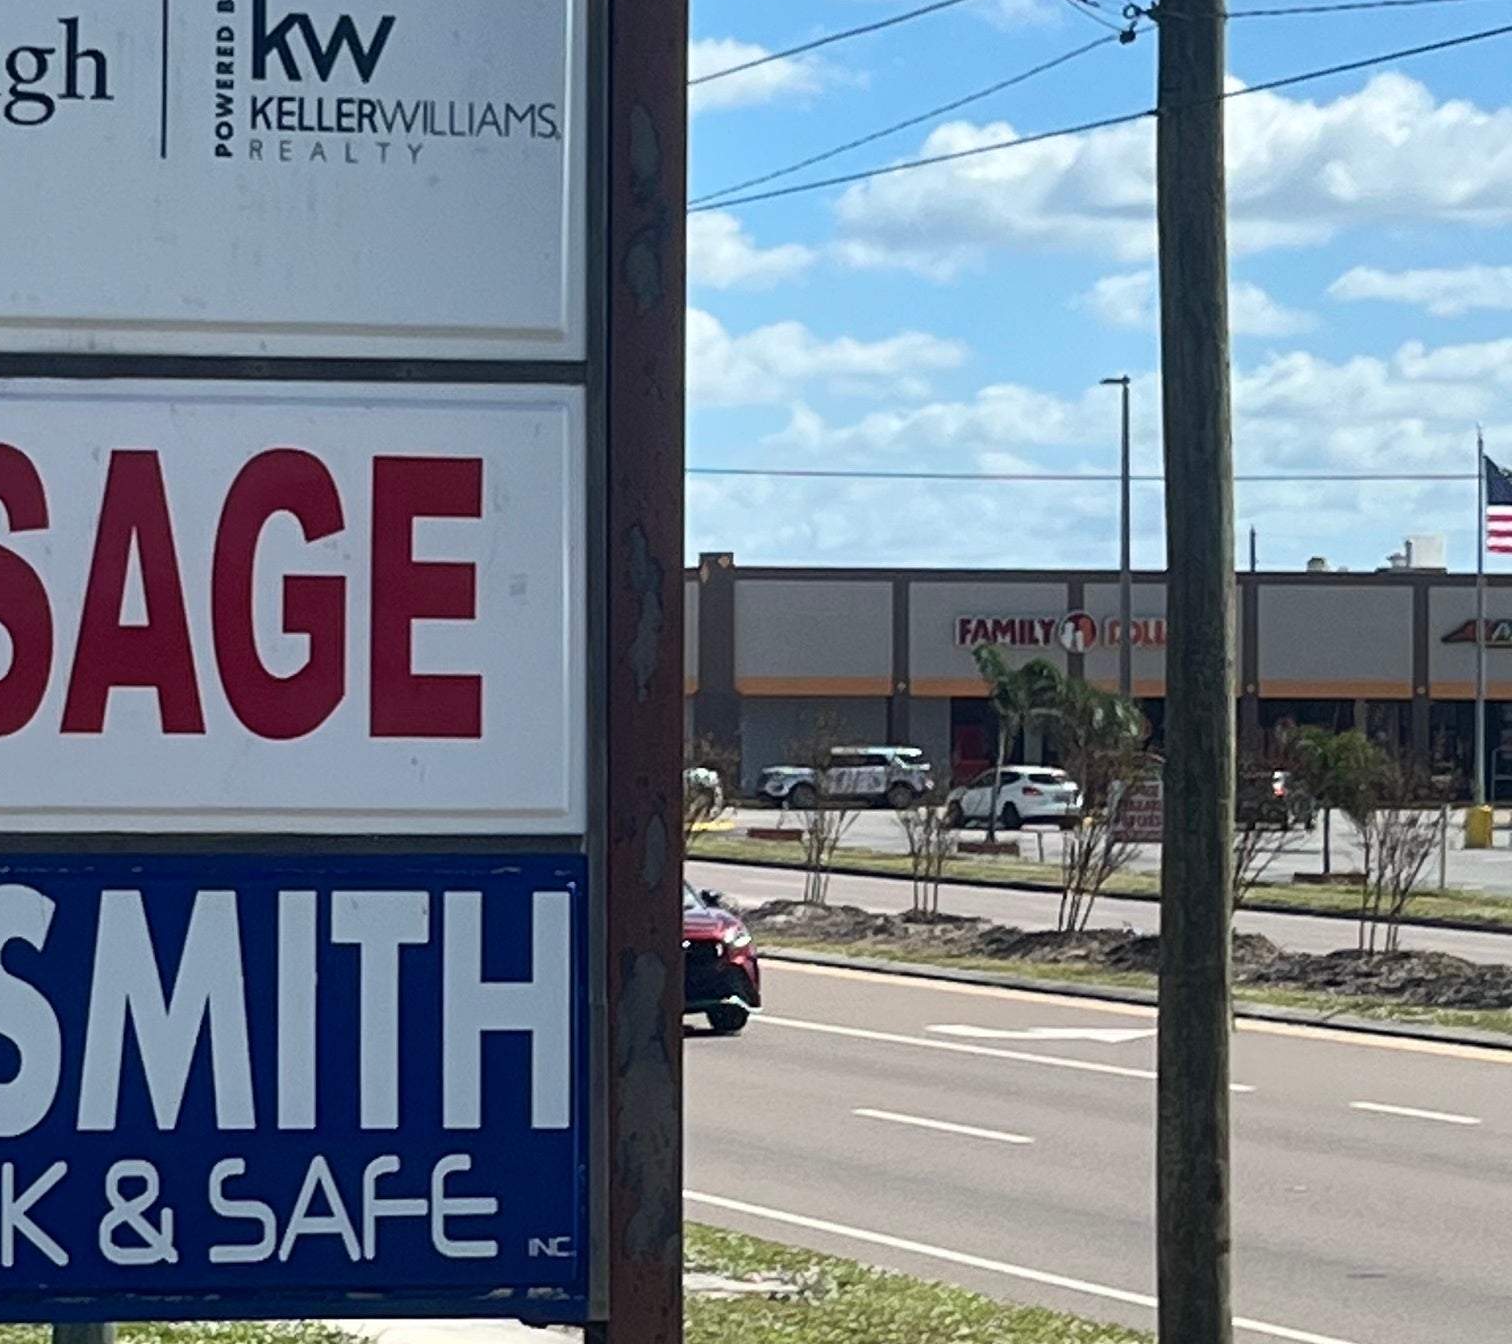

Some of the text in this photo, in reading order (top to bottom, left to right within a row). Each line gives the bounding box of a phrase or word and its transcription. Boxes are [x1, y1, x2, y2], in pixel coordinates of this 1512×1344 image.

[214, 25, 235, 158] POWERED
[248, 139, 424, 165] REALTY
[958, 618, 1056, 646] FAMILY
[98, 1159, 179, 1265] &
[208, 1153, 498, 1263] SAFE
